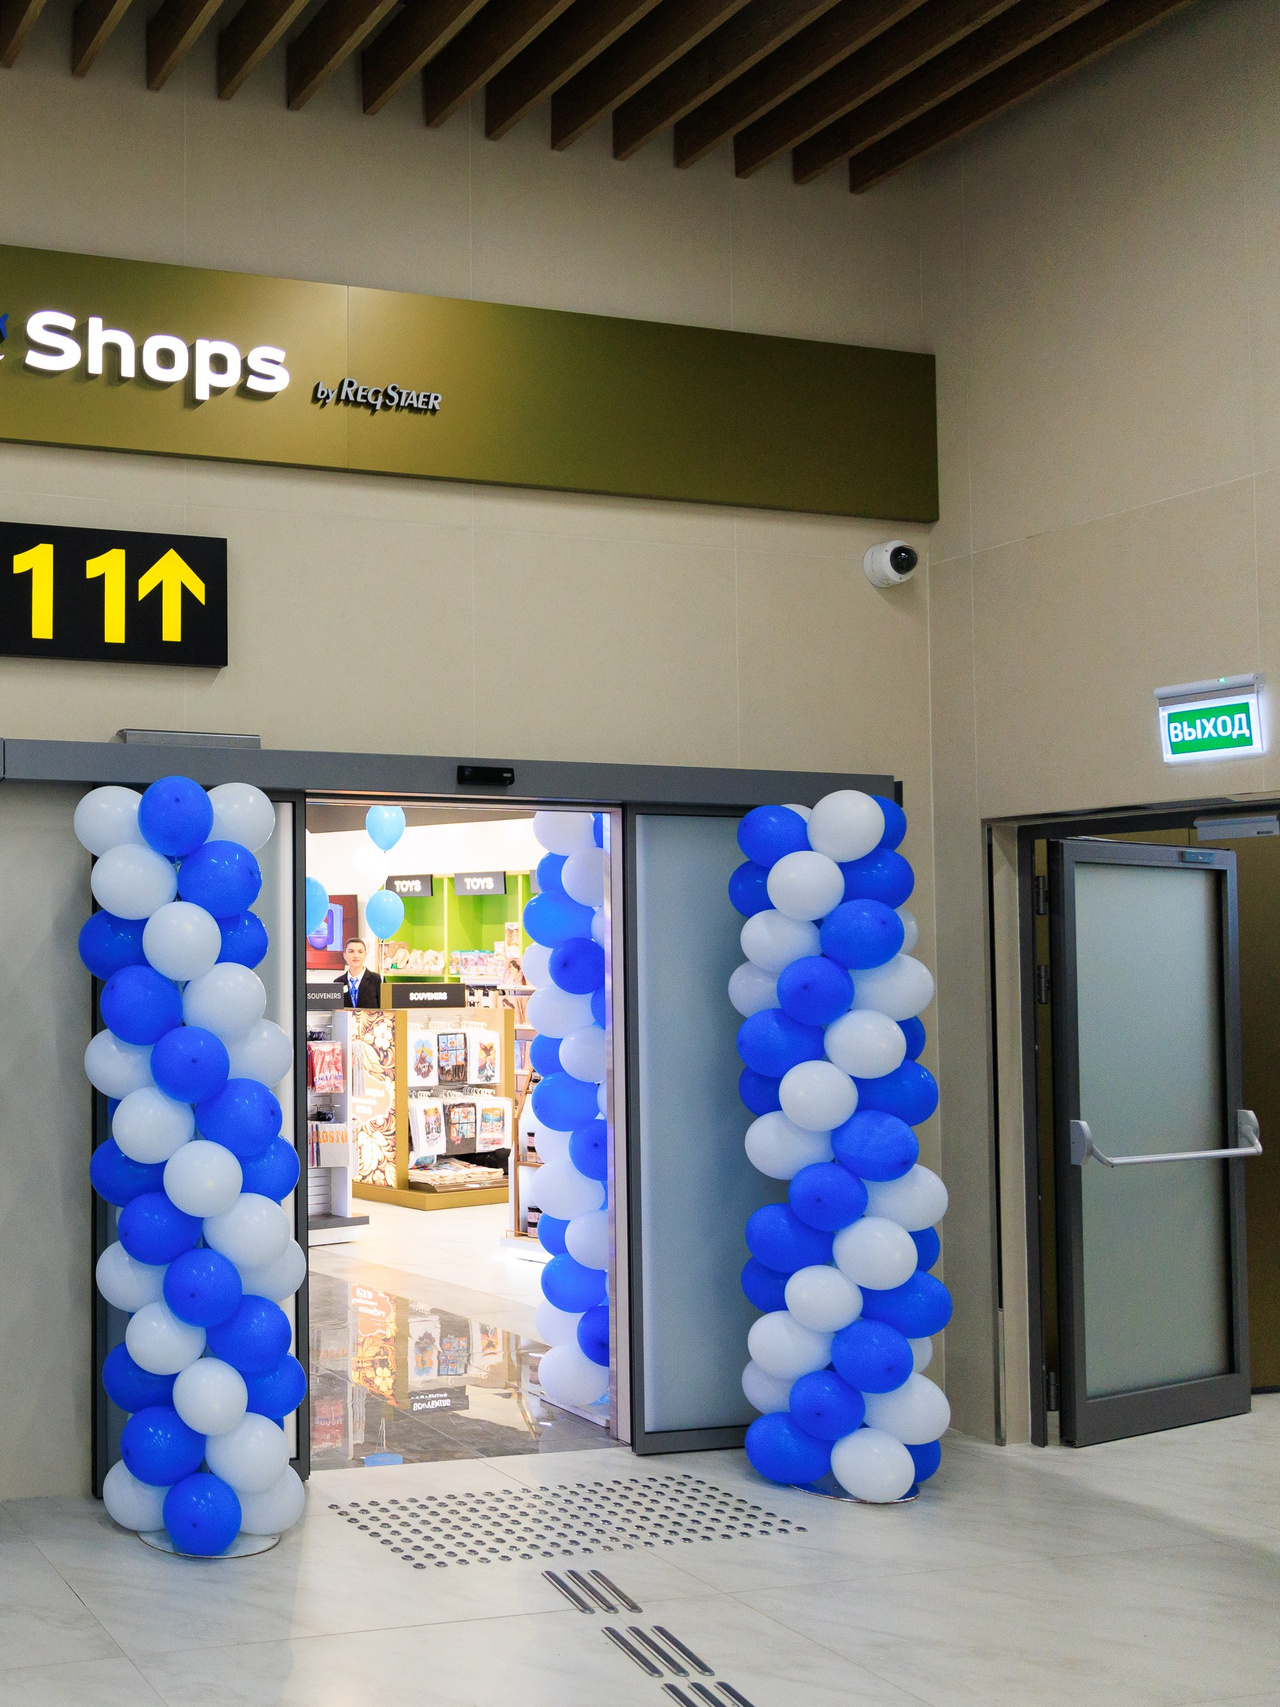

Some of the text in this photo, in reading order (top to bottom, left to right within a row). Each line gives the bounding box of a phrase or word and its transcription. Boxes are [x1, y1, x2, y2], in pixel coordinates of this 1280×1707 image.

[25, 311, 291, 401] Shops
[317, 381, 338, 403] by
[1169, 713, 1250, 742] ВЫХОД
[394, 880, 422, 893] TOYS
[465, 877, 494, 890] TOYS
[307, 993, 342, 1001] SOUVENIRS
[409, 992, 448, 1002] SOUVENIRS
